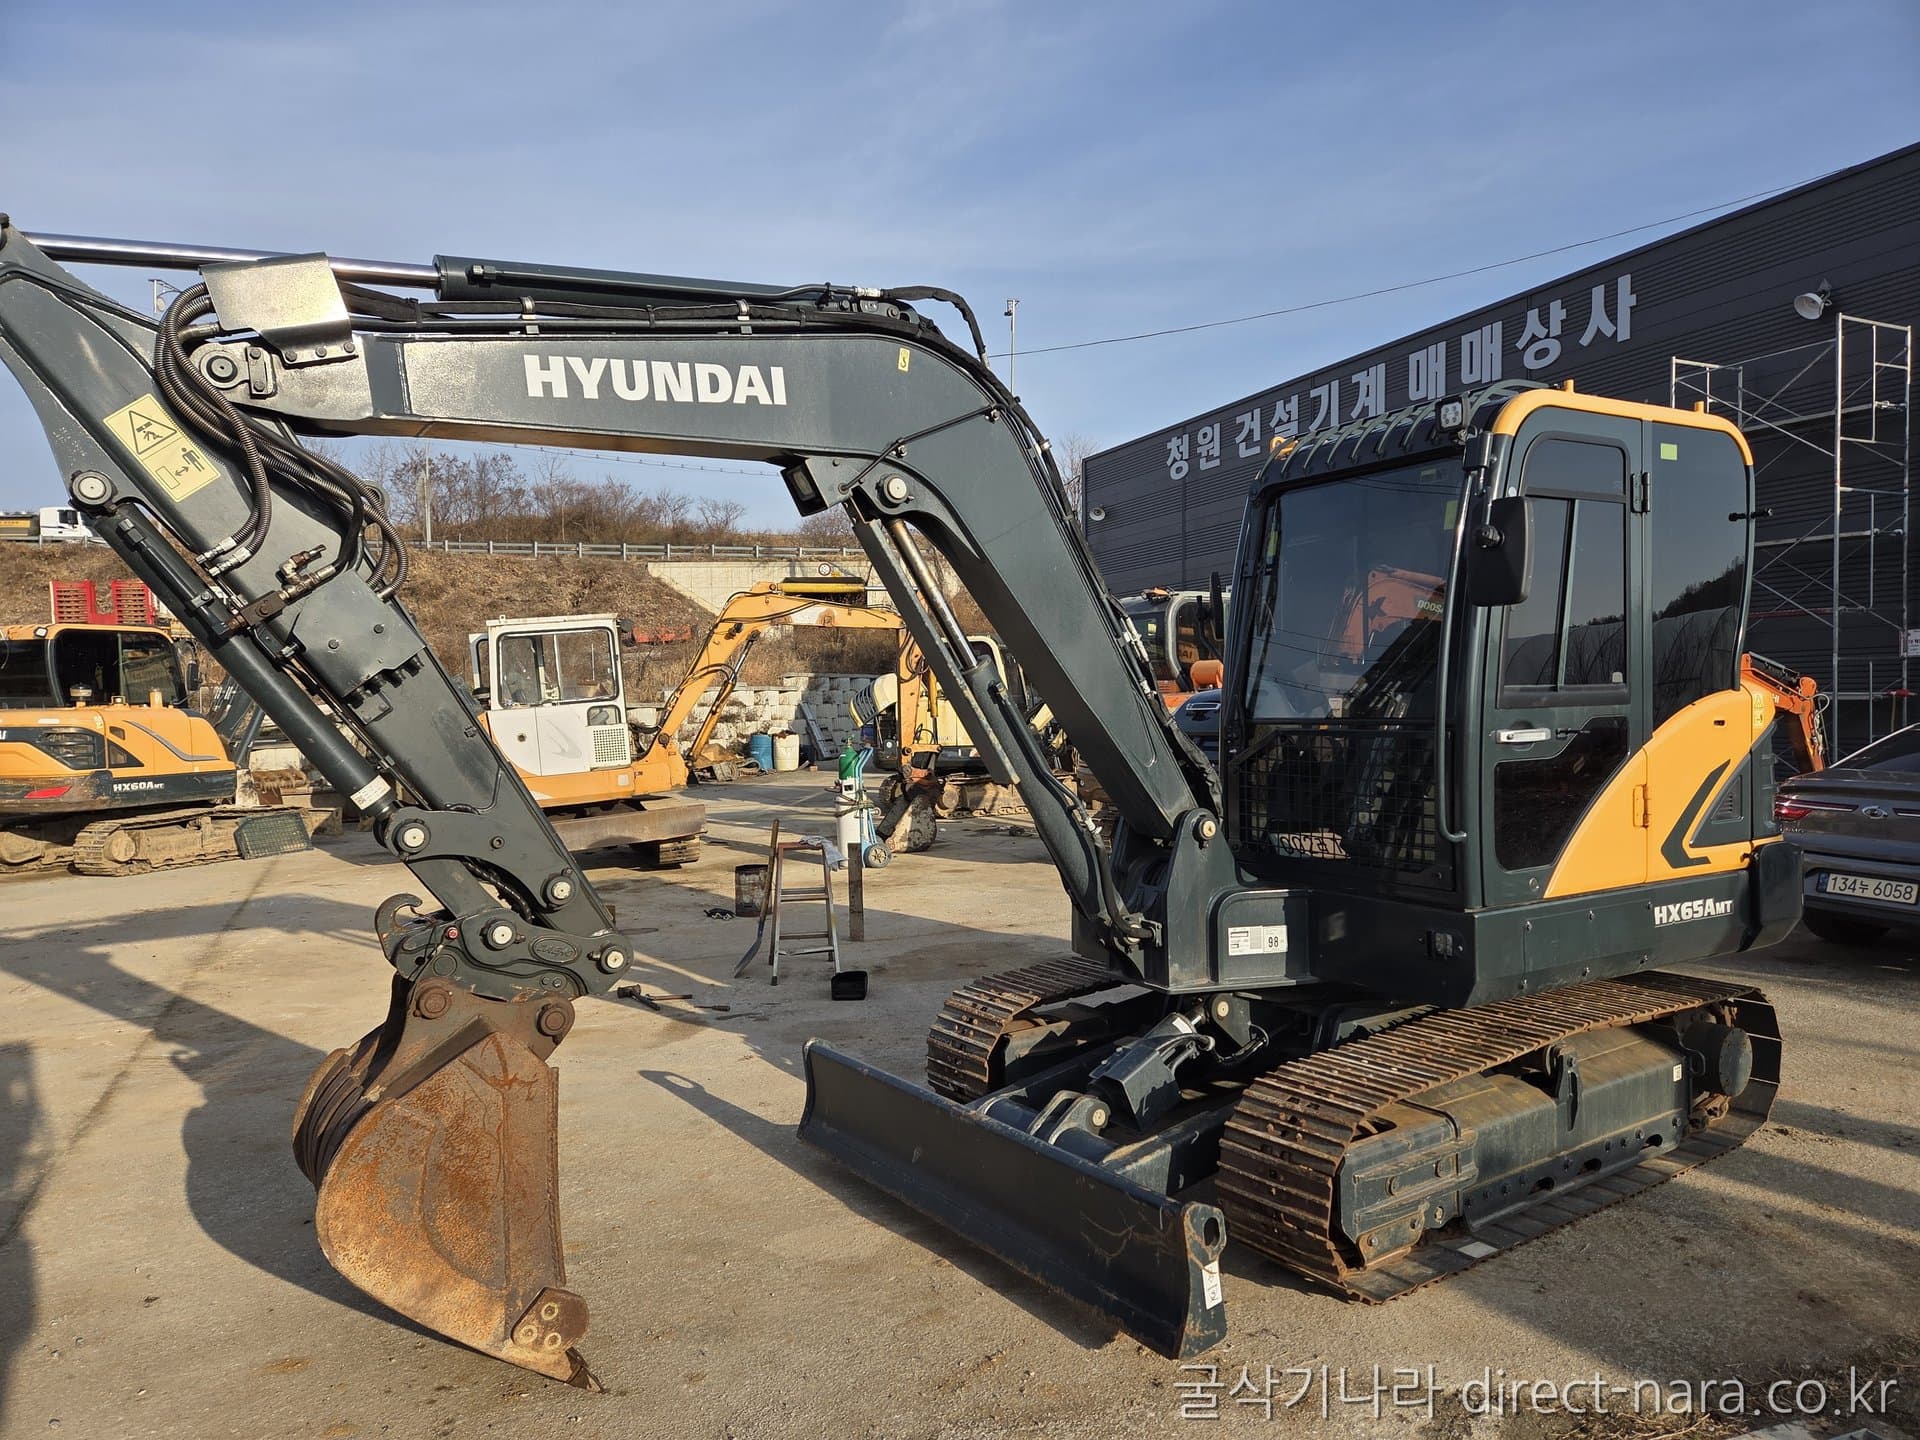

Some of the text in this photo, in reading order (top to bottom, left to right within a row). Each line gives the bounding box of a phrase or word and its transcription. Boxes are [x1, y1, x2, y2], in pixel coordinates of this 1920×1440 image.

[523, 354, 788, 406] HYUNDAI
[1166, 422, 1220, 481] 청원
[1235, 362, 1386, 459] 건설기계
[1830, 876, 1914, 900] 134누 6058
[1268, 936, 1279, 948] 98
